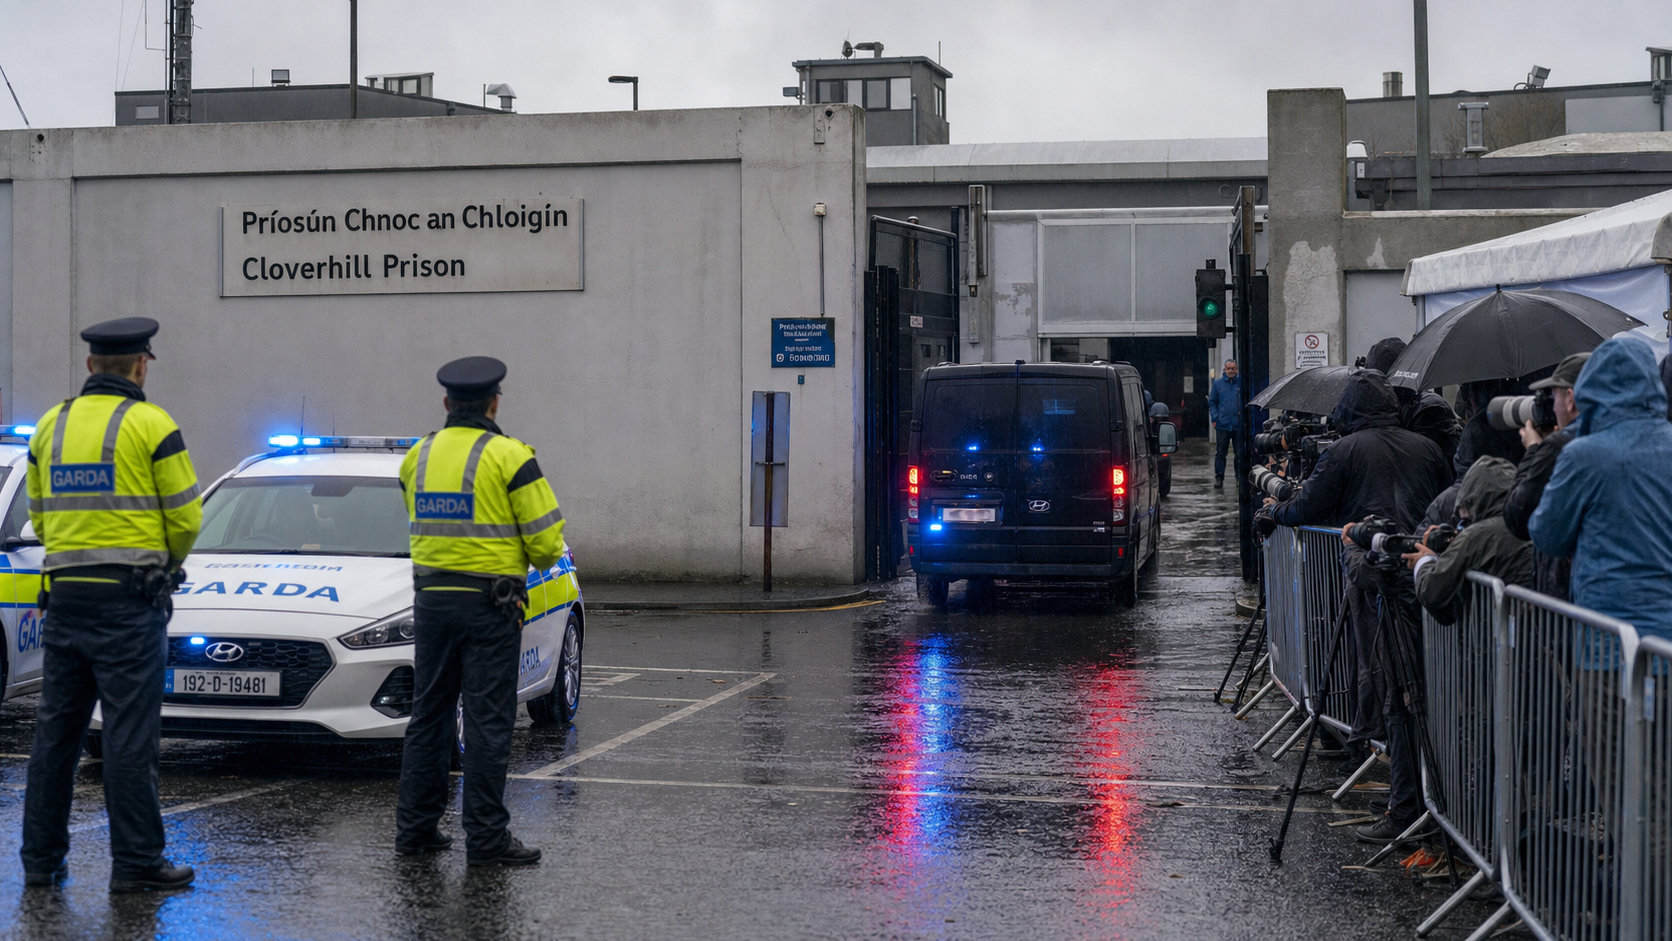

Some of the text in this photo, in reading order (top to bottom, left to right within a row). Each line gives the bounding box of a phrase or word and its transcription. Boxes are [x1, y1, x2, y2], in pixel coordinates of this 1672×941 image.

[242, 203, 568, 234] Príosún Chnoc an Chloigín
[242, 253, 465, 281] Cloverhill Prison
[53, 469, 110, 487] GARDA
[416, 497, 469, 514] GARDA
[183, 674, 266, 693] 192-D-19481
